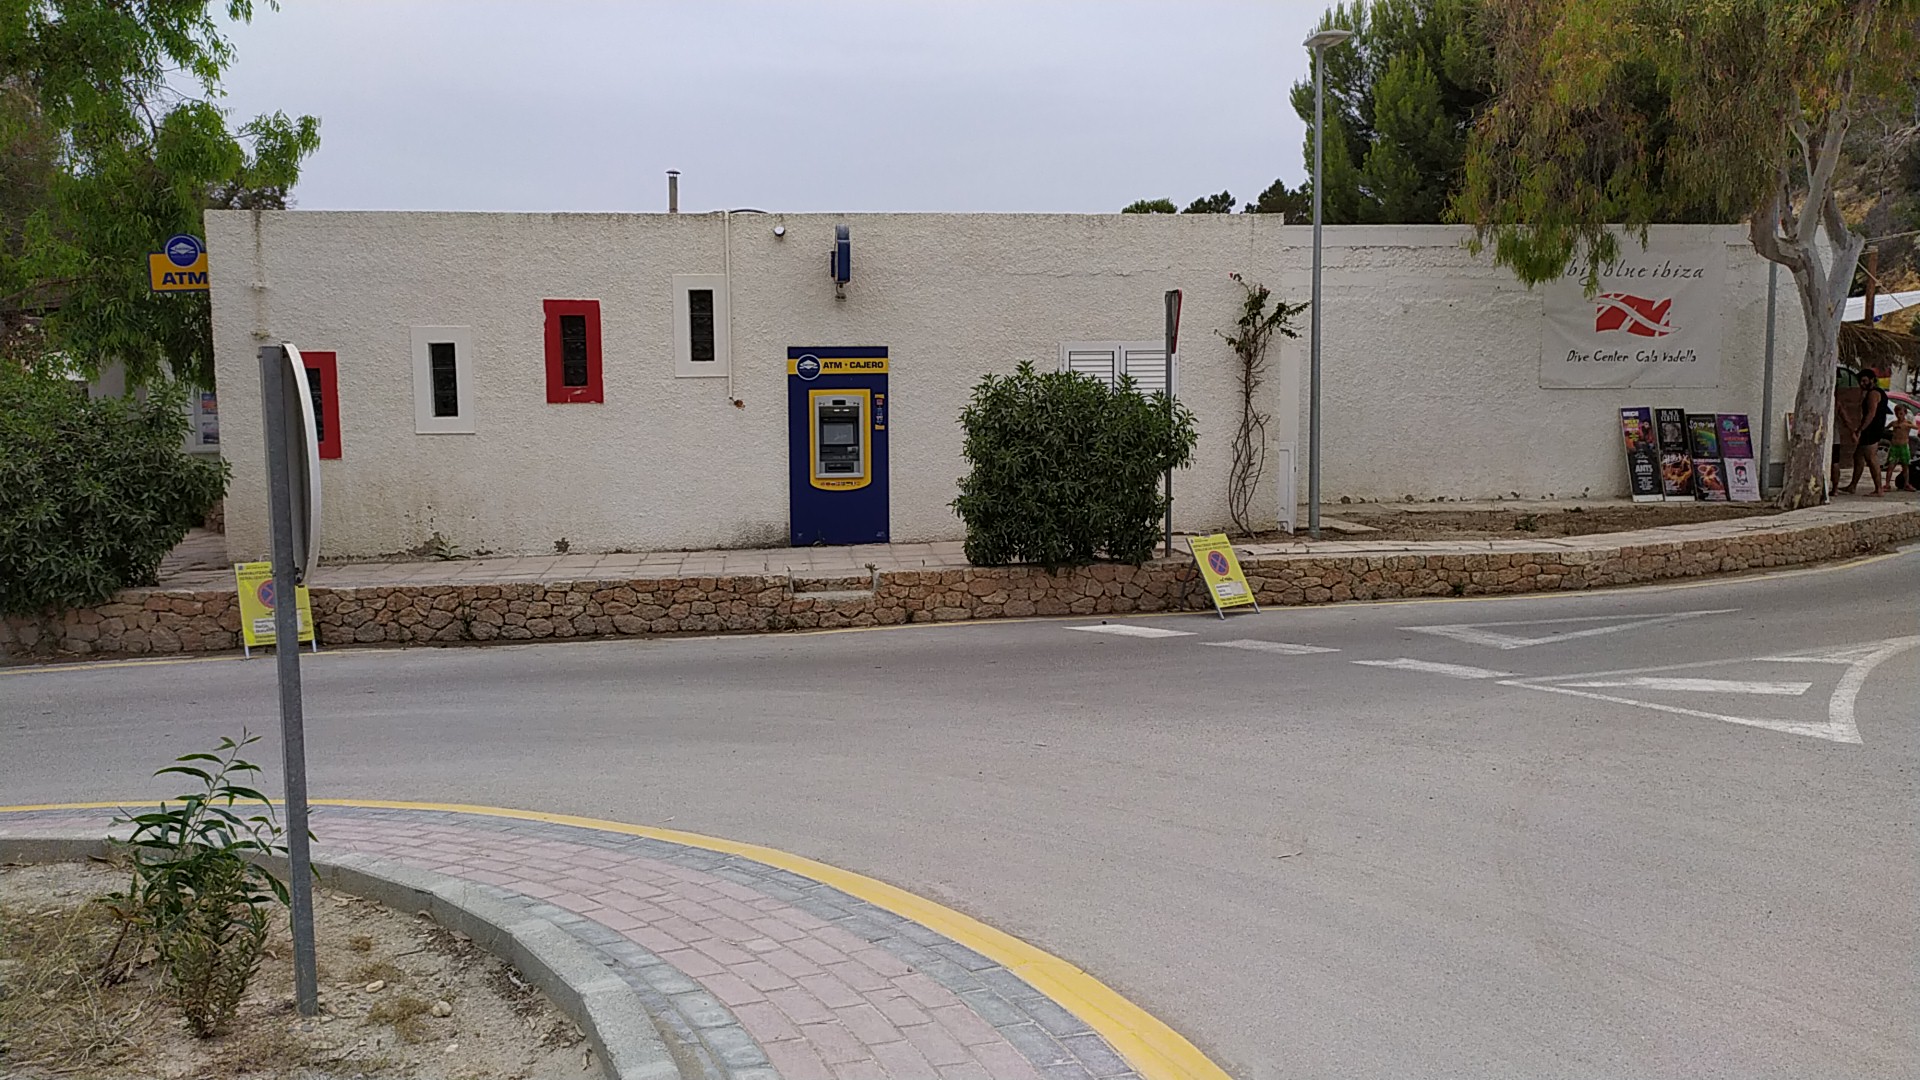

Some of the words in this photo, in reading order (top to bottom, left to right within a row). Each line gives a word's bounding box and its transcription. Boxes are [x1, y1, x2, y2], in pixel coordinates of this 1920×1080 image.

[1603, 259, 1648, 278] blue
[1652, 260, 1705, 279] ibiza
[162, 272, 207, 285] ATM
[1566, 349, 1589, 362] Dive
[1593, 349, 1629, 362] Center
[1636, 349, 1658, 362] Cala
[1663, 349, 1697, 362] Vadella
[823, 361, 842, 369] ATM
